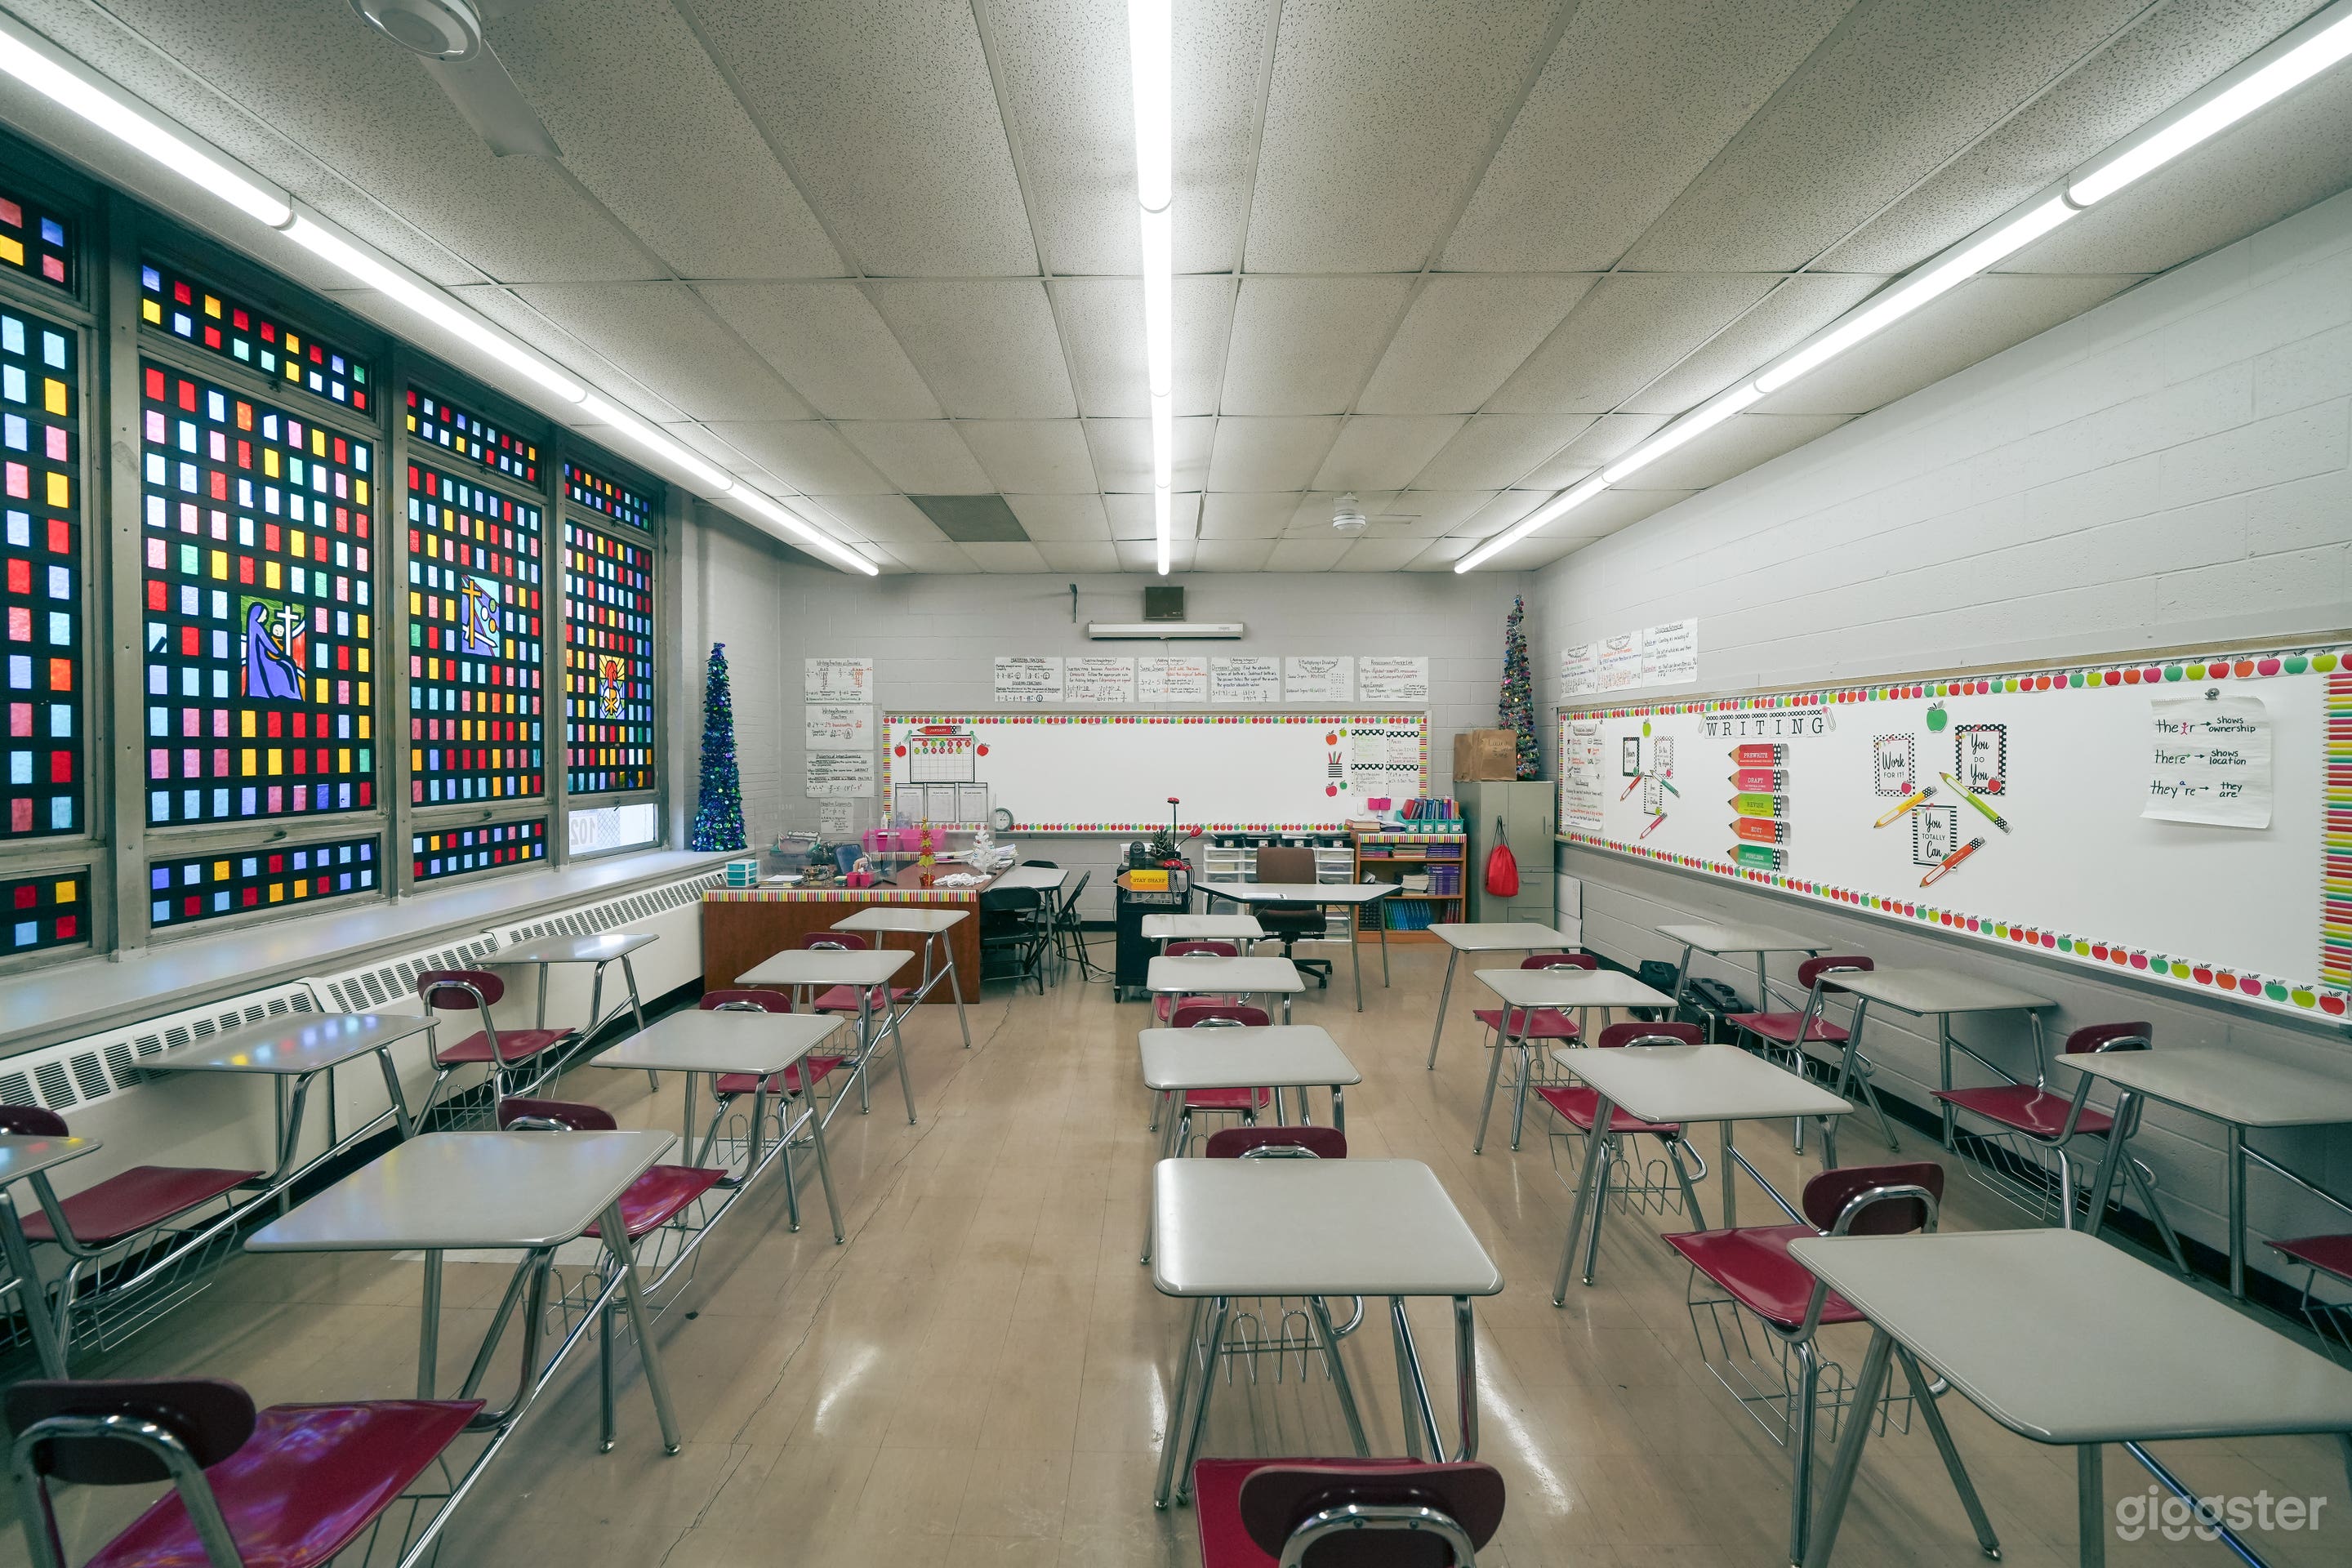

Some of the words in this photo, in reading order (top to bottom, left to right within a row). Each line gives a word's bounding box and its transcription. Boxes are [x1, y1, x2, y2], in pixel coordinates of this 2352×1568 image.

[2216, 715, 2244, 724] shows
[1706, 717, 1824, 737] WRITING
[2208, 724, 2256, 734] ownership
[1971, 733, 1990, 755] You
[1882, 751, 1906, 770] Work
[2154, 749, 2188, 764] there
[2211, 748, 2238, 757] shows
[2209, 756, 2247, 765] location
[1971, 763, 1989, 786] You
[2221, 781, 2243, 793] they
[1747, 801, 1764, 809] REVISE
[1925, 812, 1943, 833] You
[1922, 833, 1946, 841] TOTALLY
[1927, 840, 1943, 859] Can
[1745, 853, 1764, 861] PUBLISH
